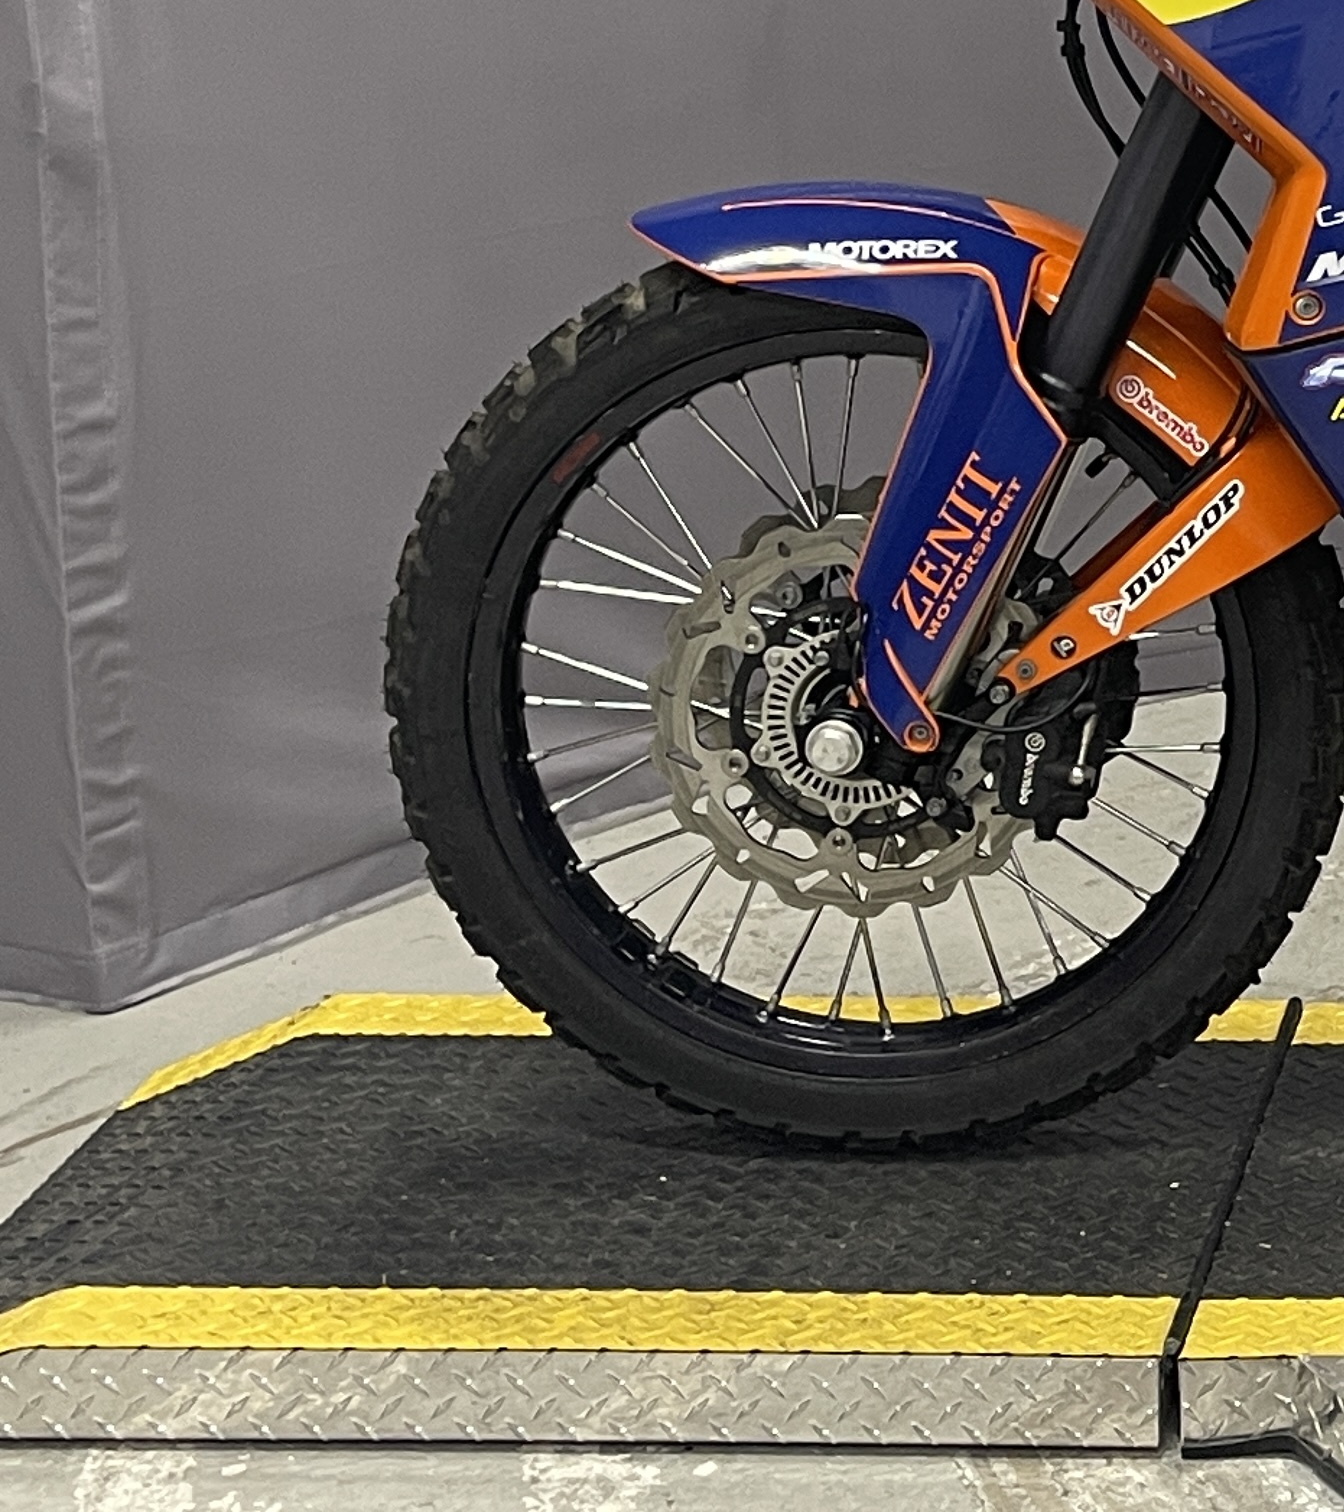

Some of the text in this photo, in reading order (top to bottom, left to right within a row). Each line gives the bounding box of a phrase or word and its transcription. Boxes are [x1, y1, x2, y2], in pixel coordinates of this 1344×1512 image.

[808, 240, 958, 259] MOTOREX
[1137, 390, 1205, 453] brembo
[892, 451, 1003, 630] ZENIT
[924, 477, 1021, 640] MOTORSPORT
[1124, 483, 1239, 605] DUNLOP
